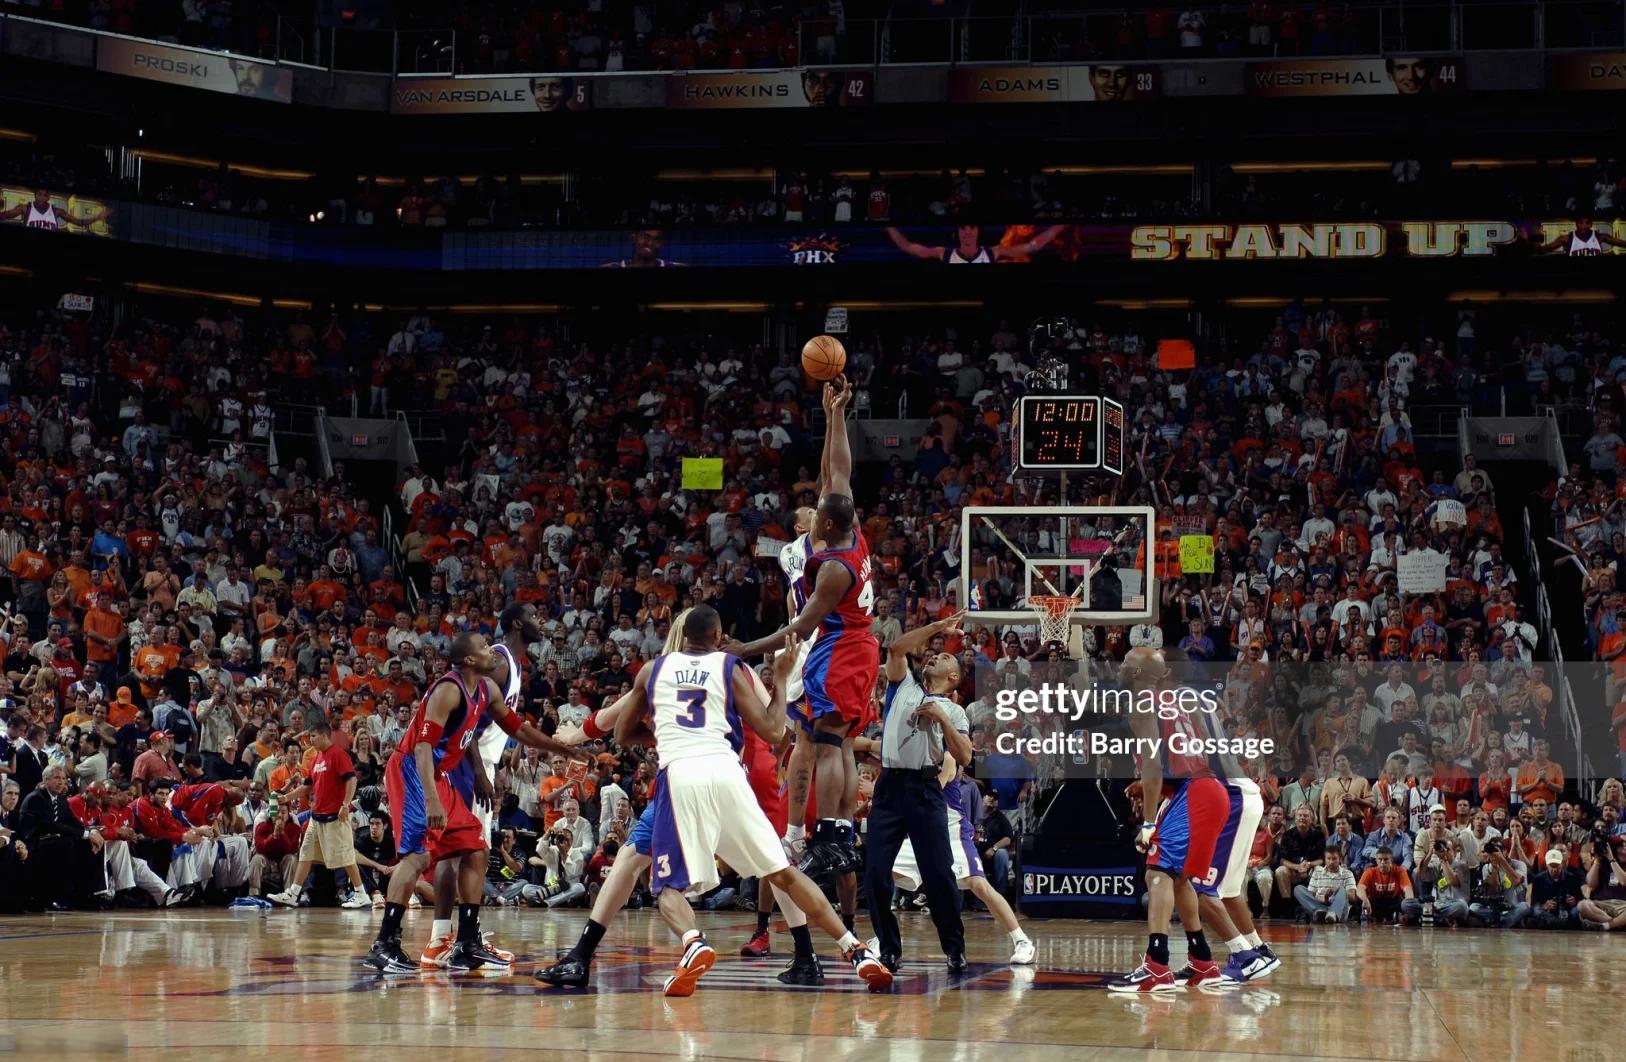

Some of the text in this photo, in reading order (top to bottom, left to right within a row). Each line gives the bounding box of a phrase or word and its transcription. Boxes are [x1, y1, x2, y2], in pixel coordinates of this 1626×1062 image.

[134, 54, 208, 78] PROSKI
[1439, 65, 1457, 83] 44
[1590, 66, 1626, 78] DA
[848, 79, 864, 97] 42
[979, 78, 1060, 92] ADAMS
[1136, 72, 1154, 92] 33
[1255, 71, 1381, 88] WESTPHAL
[398, 89, 527, 106] VAN ARSDALE
[576, 85, 587, 103] 5
[683, 84, 790, 98] HAWKINS
[1130, 222, 1387, 261] STAND
[1402, 220, 1519, 257] UP
[793, 249, 836, 266] PHX
[1034, 402, 1094, 422] 12:00
[1038, 430, 1084, 461] 24
[675, 670, 710, 687] DIAW
[675, 689, 707, 729] 3
[1411, 804, 1430, 816] SUN
[657, 853, 673, 879] 3
[1036, 873, 1136, 897] PLAYOFFS
[1191, 866, 1219, 887] 9
